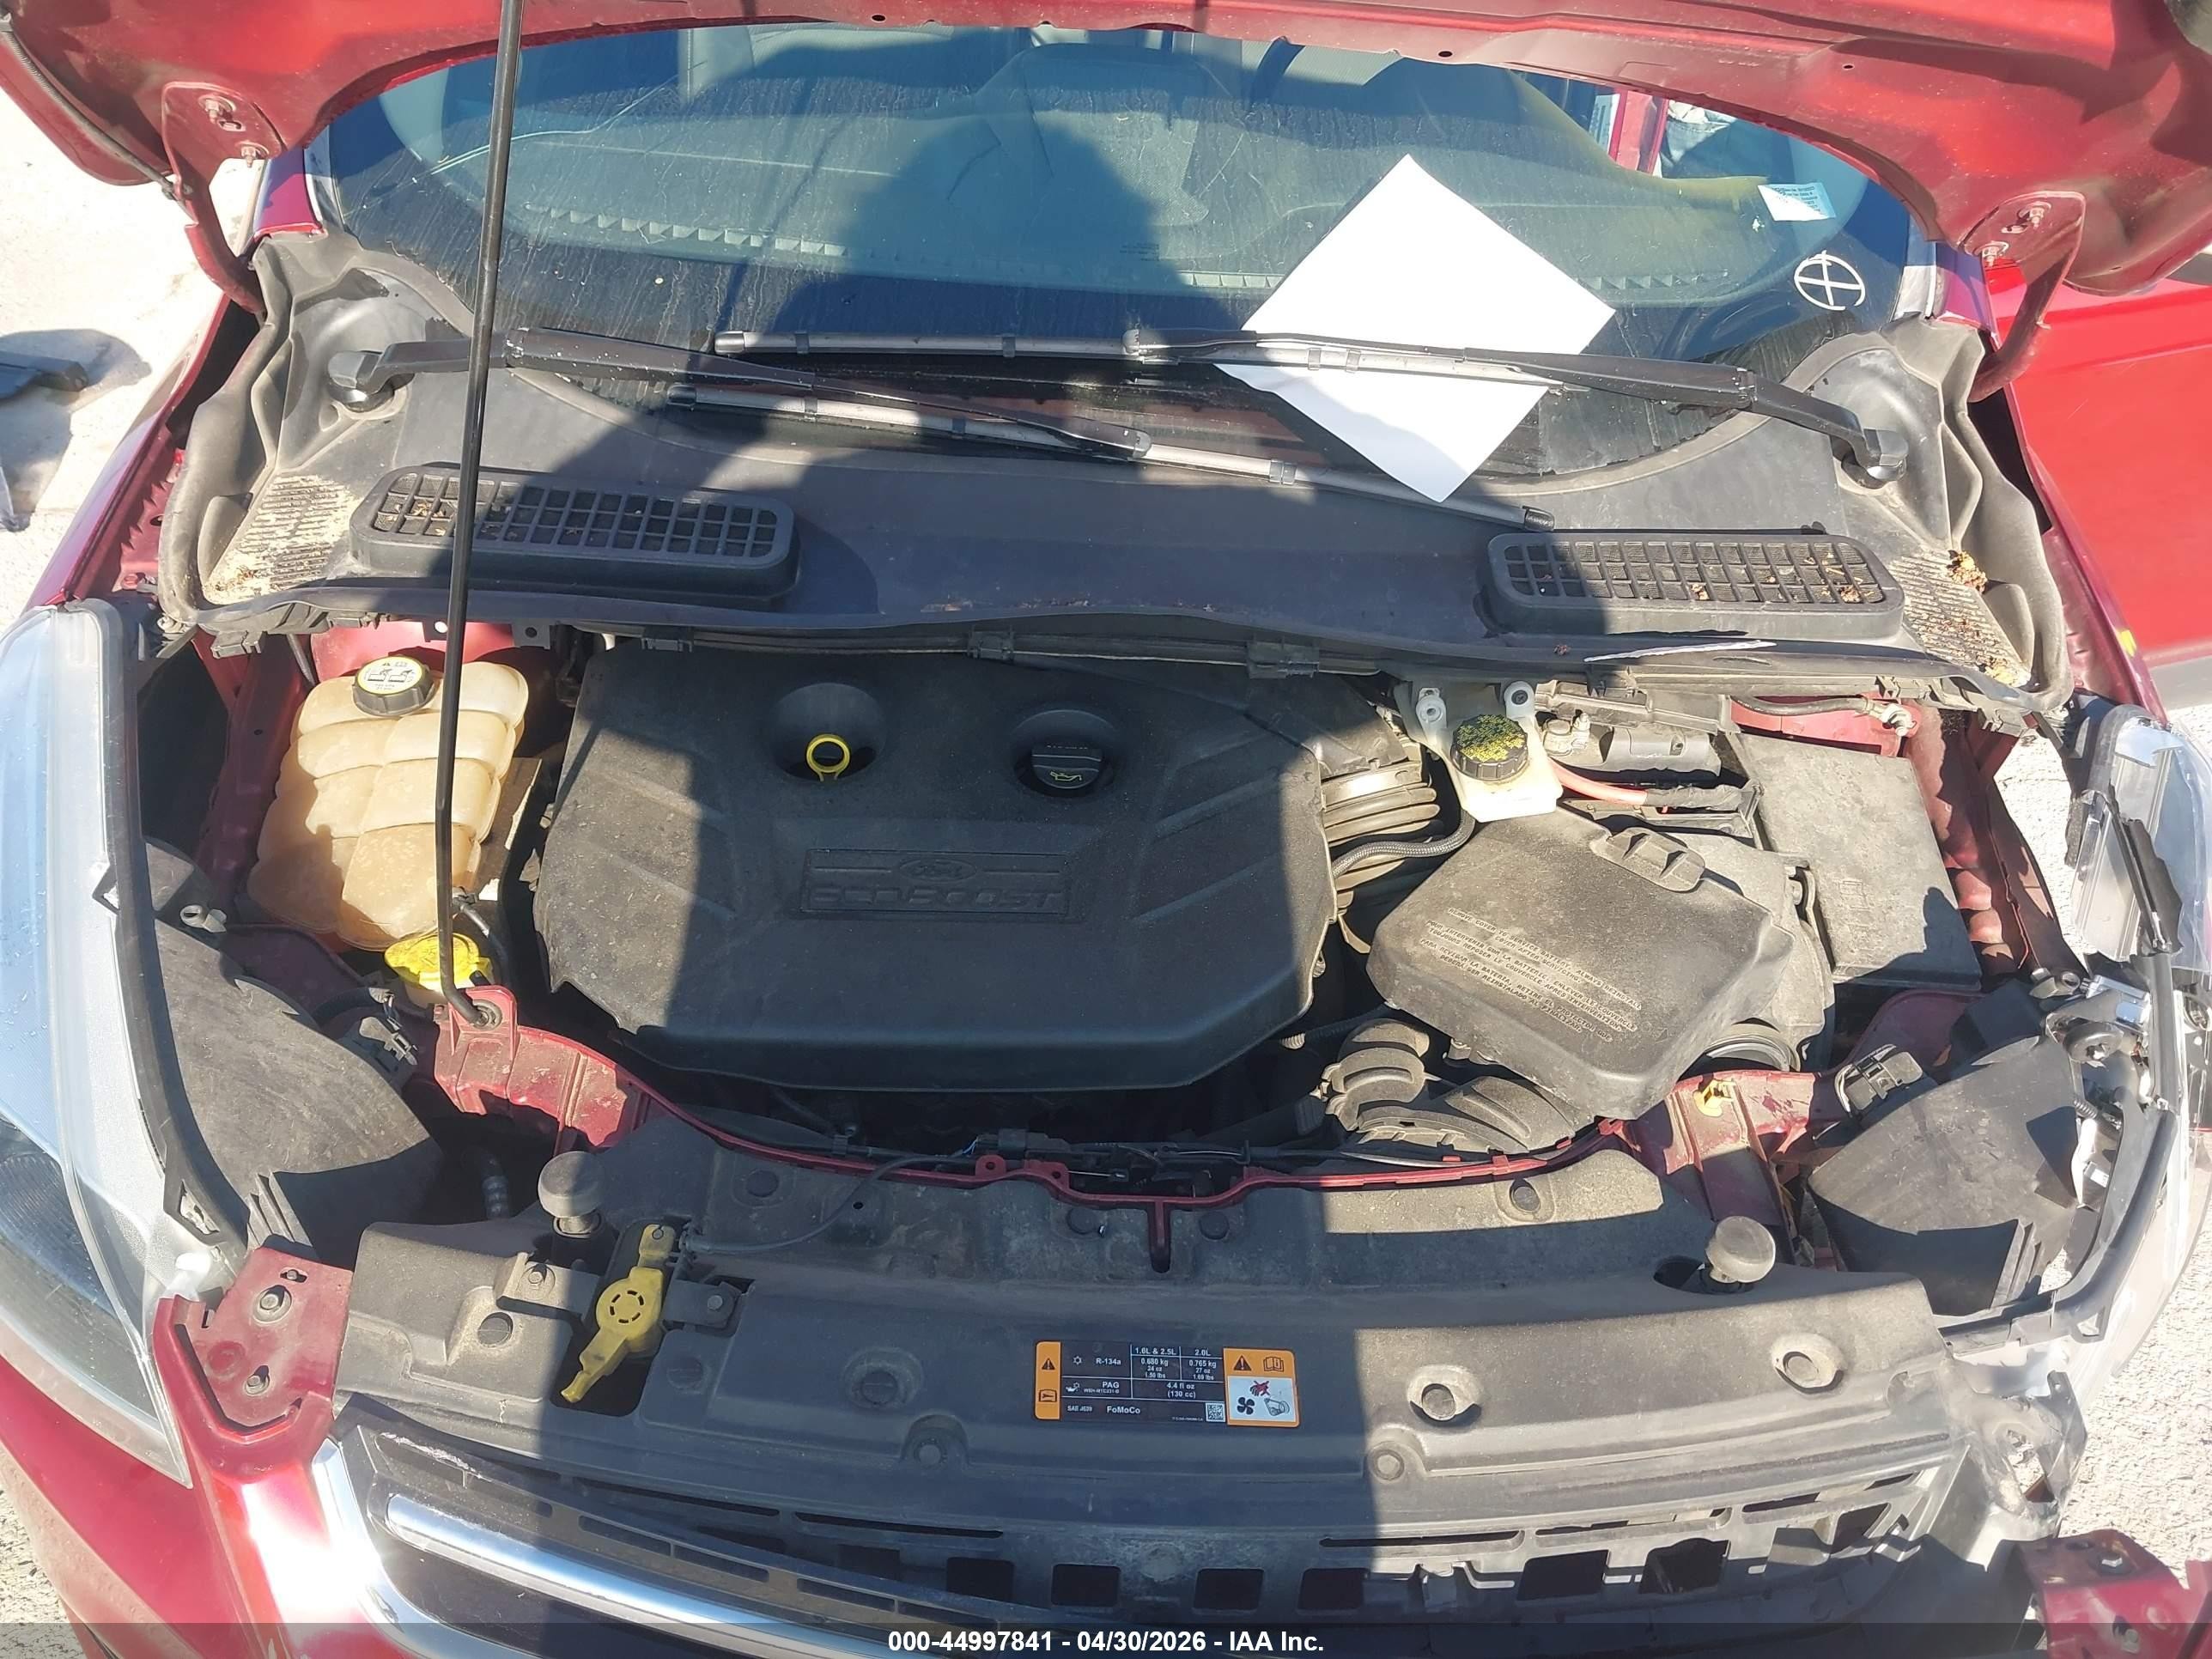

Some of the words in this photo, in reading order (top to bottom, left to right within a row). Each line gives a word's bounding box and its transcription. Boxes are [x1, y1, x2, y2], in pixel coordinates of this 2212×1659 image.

[1429, 927, 1461, 945] TOUJOURS
[1504, 962, 1542, 985] COUVERCLE
[1494, 935, 1516, 948] COVER
[1516, 946, 1539, 960] AFTER
[1426, 920, 1443, 930] POUR
[1553, 980, 1583, 999] ENLEVER
[1474, 920, 1496, 932] COVER
[1509, 934, 1539, 952] SERVICE
[1576, 969, 1603, 987] ALWAYS
[1603, 984, 1642, 1009] REINSTALL
[1516, 983, 1542, 1000] RETIRE
[1160, 1358, 1169, 1367] kg
[1208, 1360, 1217, 1369] kg
[1106, 1405, 1141, 1414] FoMoCo
